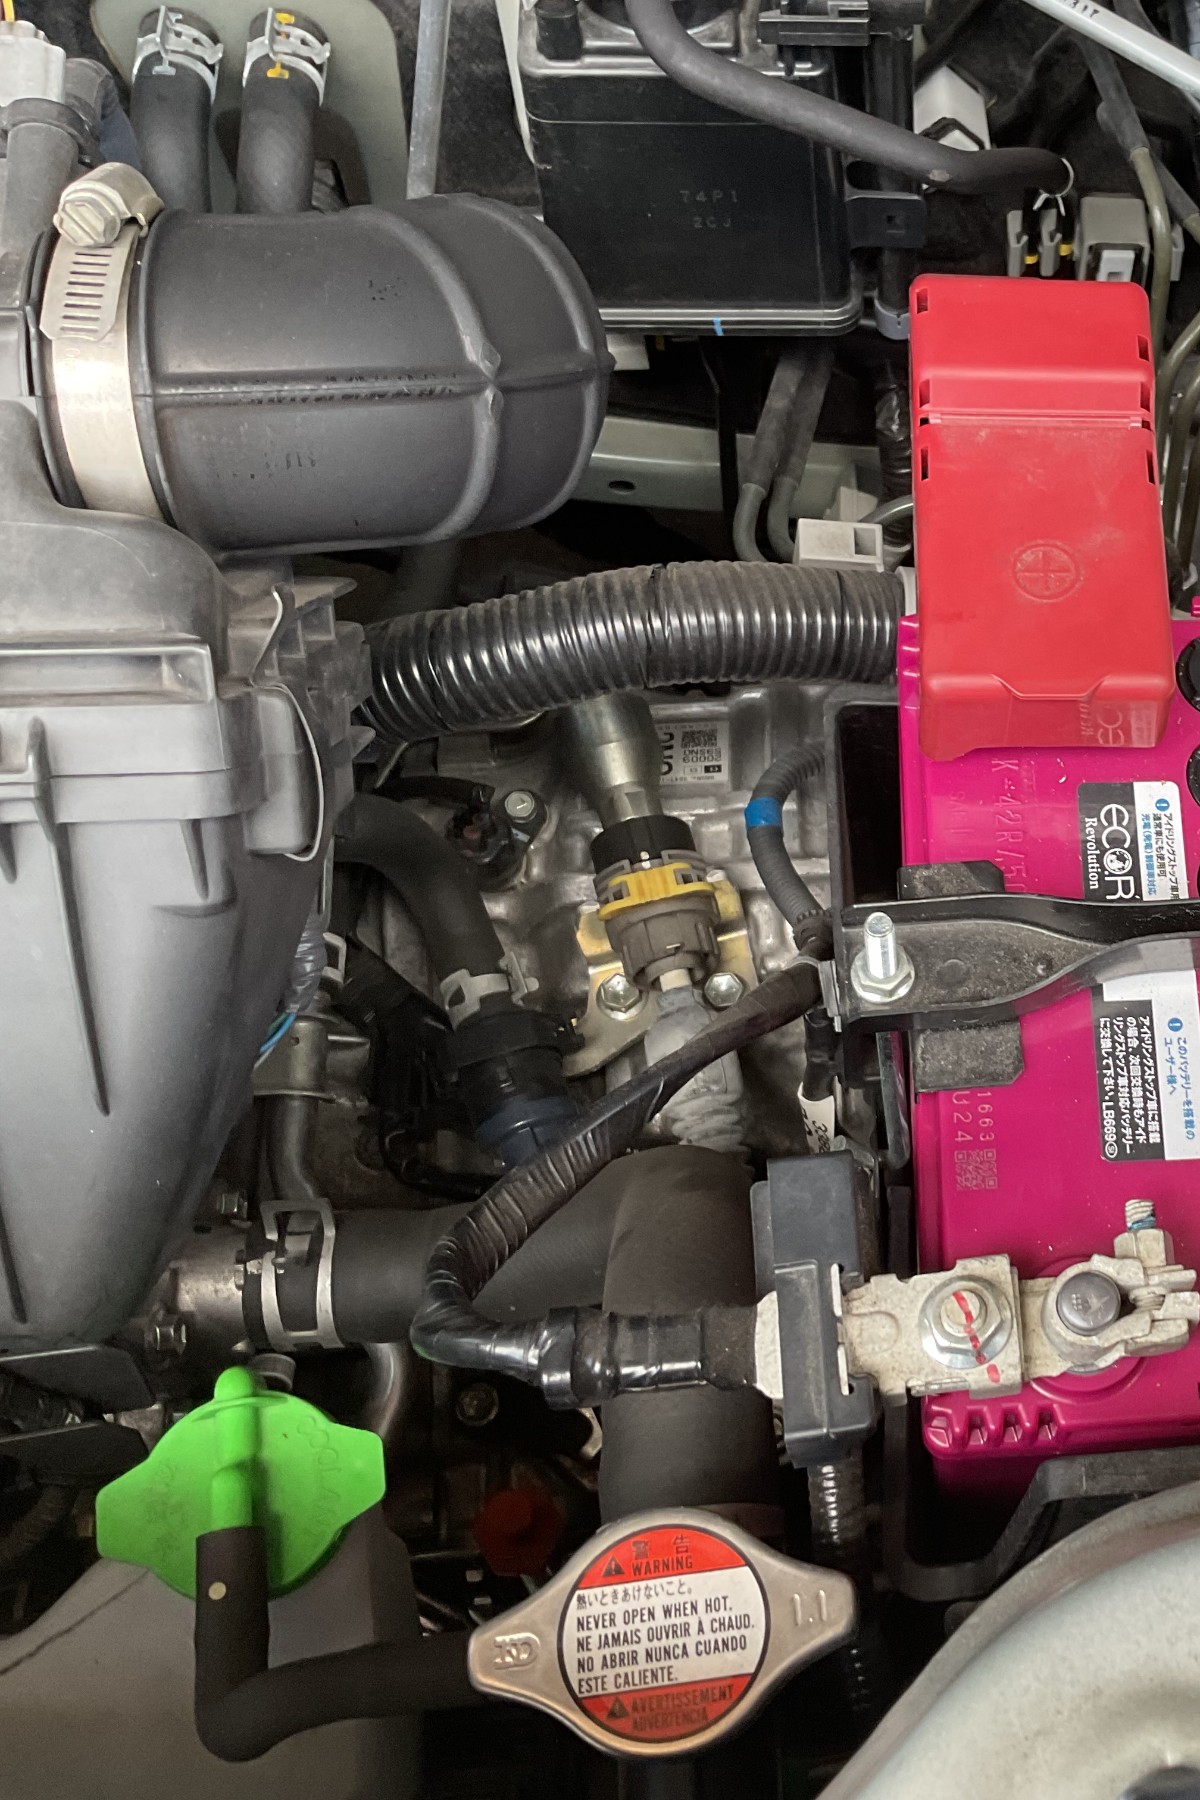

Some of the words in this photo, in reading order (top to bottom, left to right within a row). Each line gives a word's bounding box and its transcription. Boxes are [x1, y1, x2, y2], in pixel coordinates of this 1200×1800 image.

[1085, 817, 1101, 889] Revolution
[1152, 813, 1167, 878] 通常車にも使用可
[1113, 1017, 1134, 1154] リングストップ車対応バッテリー
[1126, 1017, 1146, 1144] の場合、次回交換時もアイド
[1139, 1015, 1160, 1144] アイドリングストップ車に搭載
[1164, 1037, 1177, 1095] ユーザー様へ
[1177, 1036, 1195, 1140] このバッテリーを搭載の
[977, 1091, 995, 1141] 1663
[632, 1555, 693, 1577] WARNING
[577, 1611, 617, 1632] NEVER
[623, 1606, 656, 1626] OPEN
[662, 1600, 698, 1620] WHEN
[705, 1596, 733, 1614] HOT.
[577, 1635, 592, 1653] NE
[597, 1630, 641, 1650] JAMAIS
[647, 1622, 691, 1643] OUVRIR
[697, 1617, 705, 1635] À
[711, 1614, 755, 1633] CHAUD.
[577, 1656, 594, 1674] NO
[601, 1650, 639, 1671] ABRIR
[645, 1644, 689, 1664] NUNCA
[695, 1635, 747, 1657] CUANDO
[578, 1675, 607, 1695] ESTE
[614, 1666, 679, 1689] CALIENTE.
[631, 1684, 735, 1715] AVERTISSEMENT
